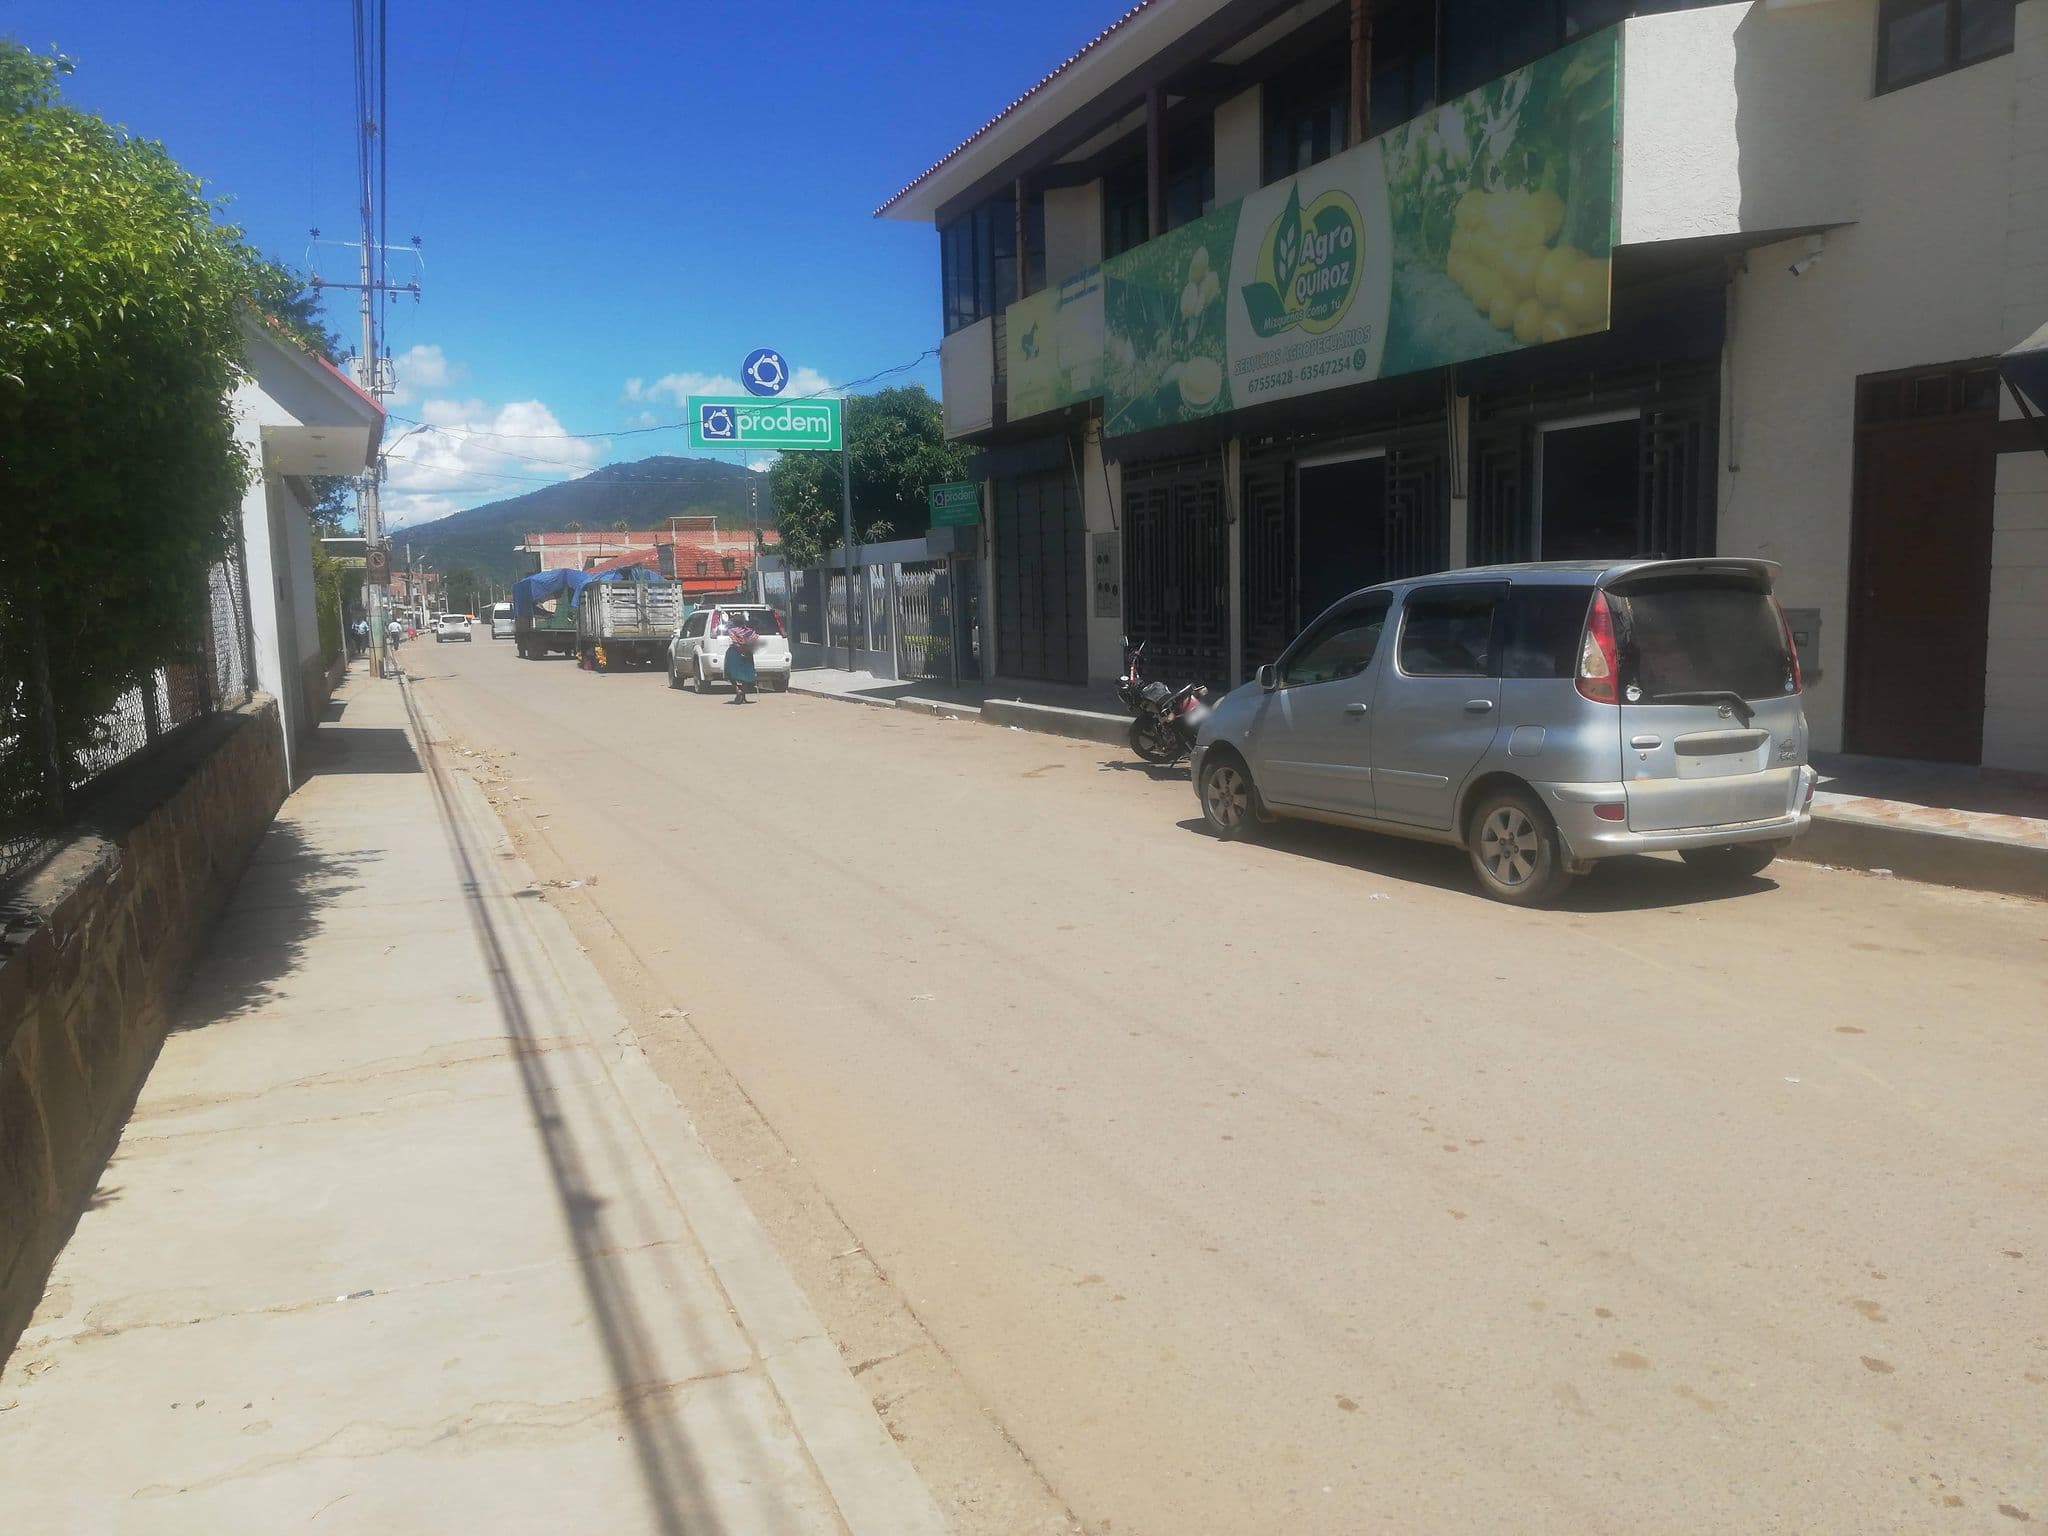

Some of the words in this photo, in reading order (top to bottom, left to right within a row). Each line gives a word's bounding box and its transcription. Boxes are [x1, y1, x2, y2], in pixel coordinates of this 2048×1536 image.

[1300, 226, 1353, 264] Agro
[1296, 261, 1350, 302] QUIROZ
[1306, 303, 1328, 319] como
[1331, 295, 1341, 310] tú
[1233, 349, 1282, 376] SERVICIOS
[1282, 324, 1372, 364] AGROPECUARIOS
[1248, 370, 1293, 393] 67555428
[1301, 356, 1350, 381] 63547254
[737, 407, 827, 440] prodem
